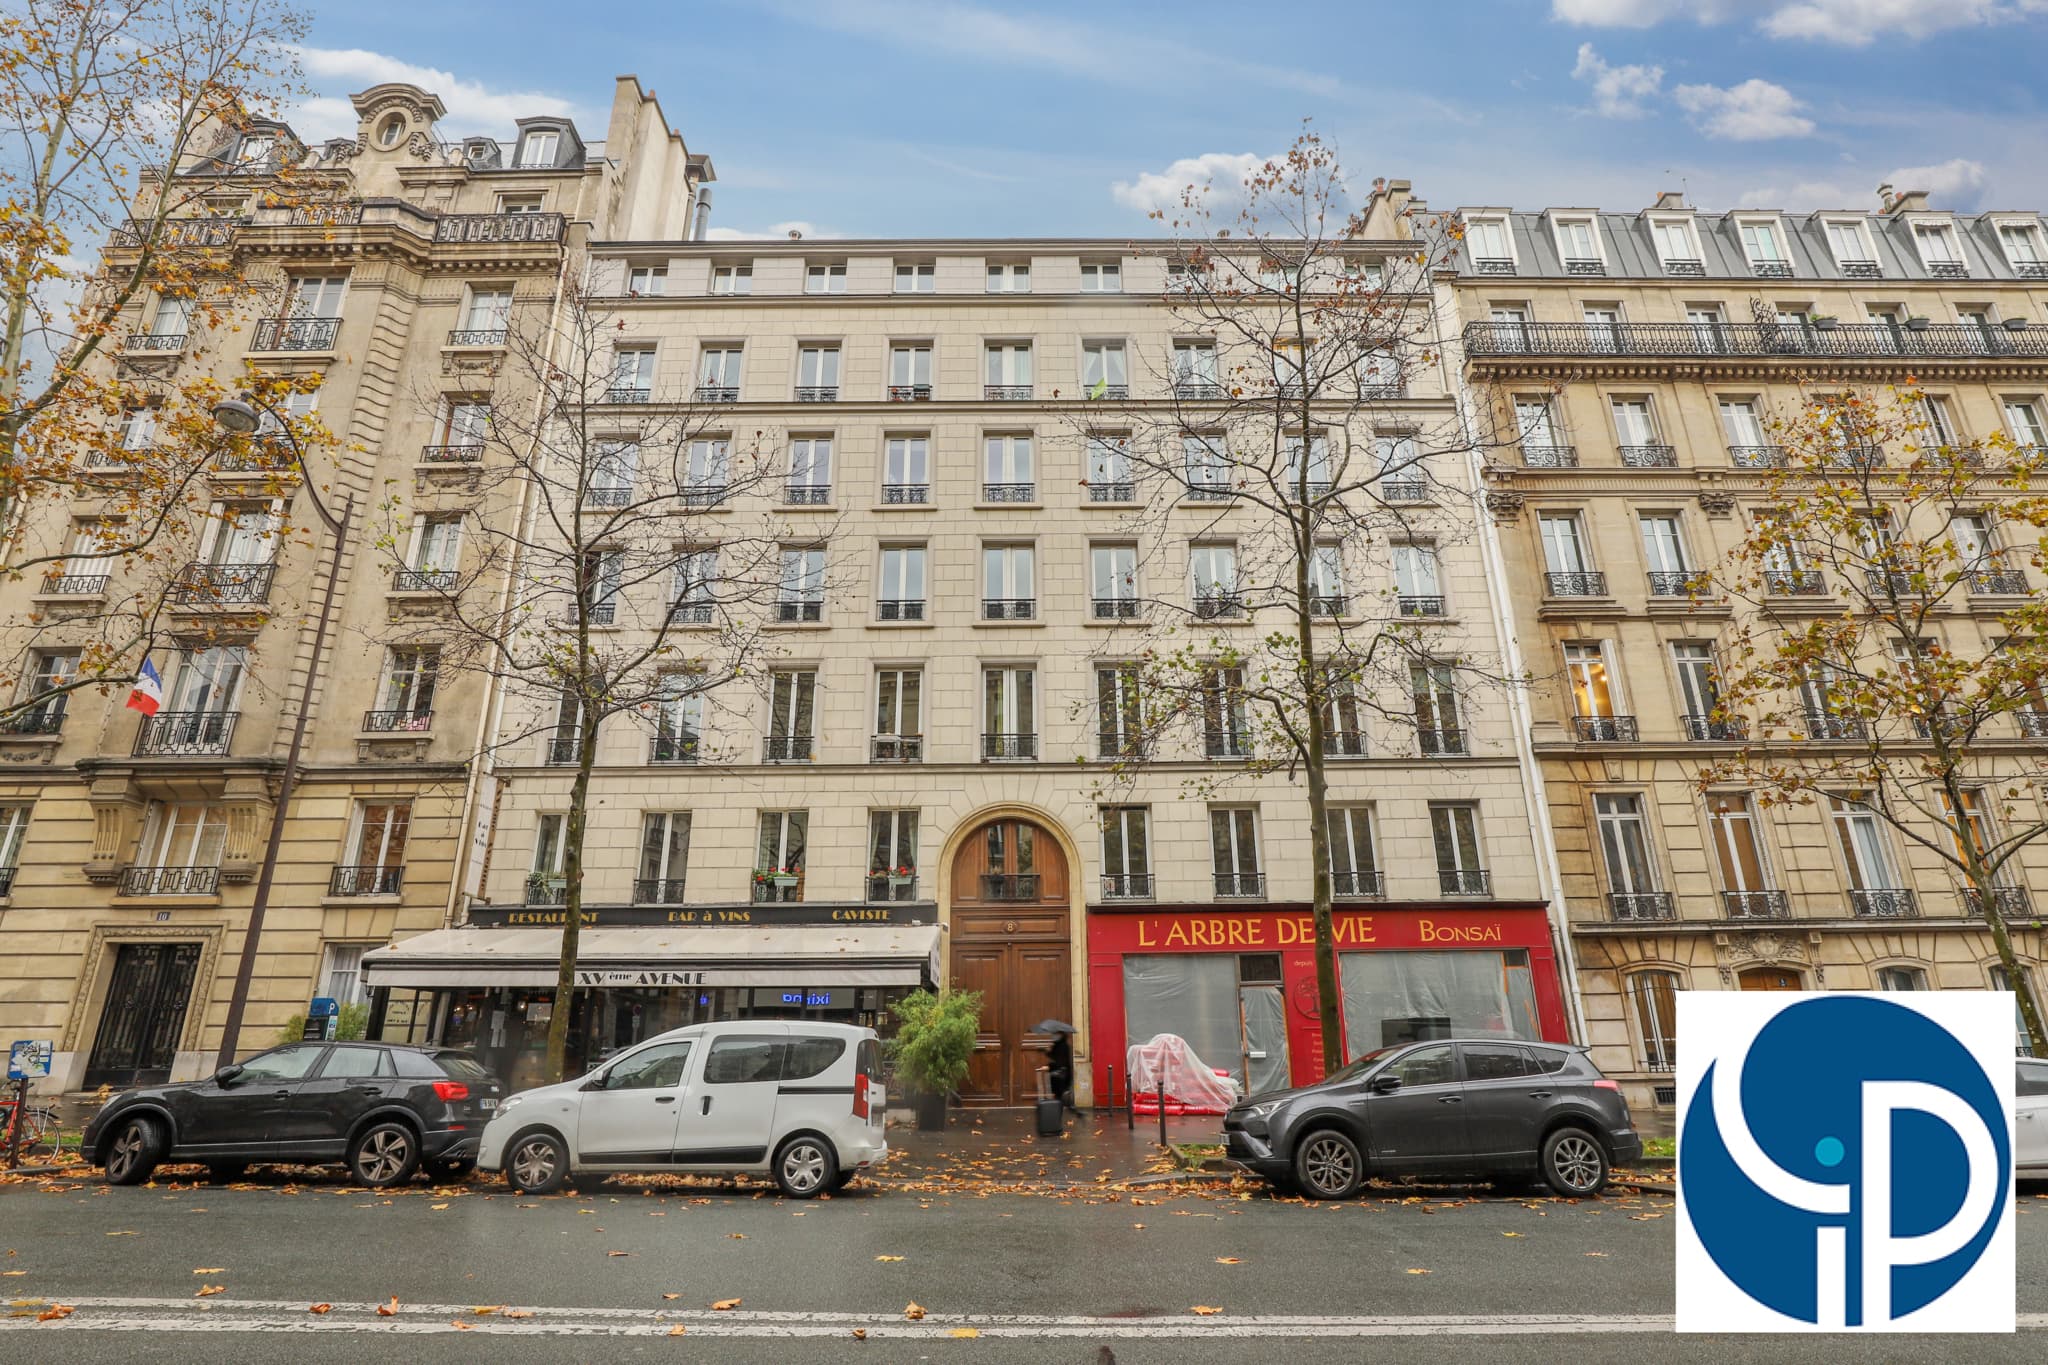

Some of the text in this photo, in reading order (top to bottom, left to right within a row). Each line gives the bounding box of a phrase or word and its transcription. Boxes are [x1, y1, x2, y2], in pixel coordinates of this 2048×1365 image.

[508, 912, 599, 923] RESTAUNT
[668, 910, 751, 922] BAR à VINS
[832, 910, 892, 920] CAVISTE
[1276, 917, 1316, 944] DE
[1331, 916, 1377, 943] VIE
[634, 972, 707, 985] AVENUE
